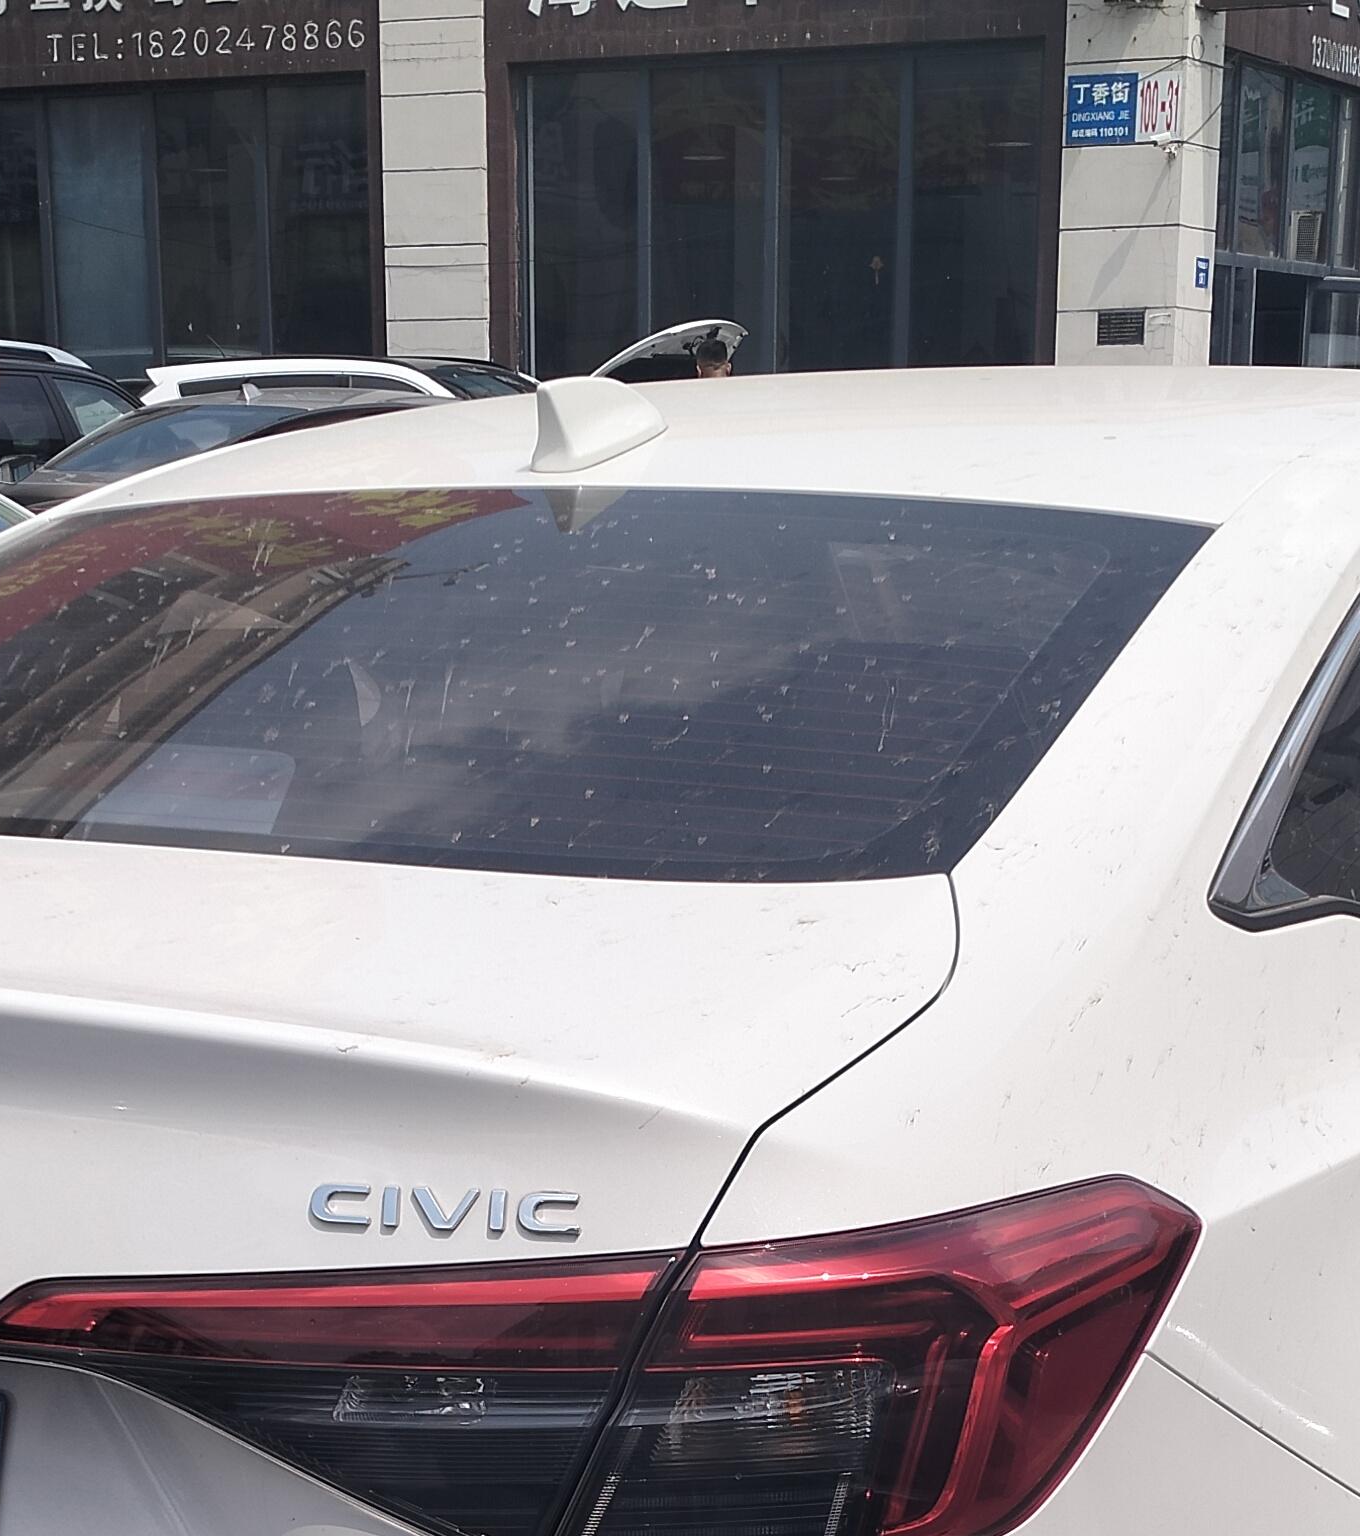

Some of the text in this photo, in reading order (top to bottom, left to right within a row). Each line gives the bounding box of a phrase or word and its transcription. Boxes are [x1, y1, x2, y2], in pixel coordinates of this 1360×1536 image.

[1072, 82, 1131, 106] 丁香街
[1140, 79, 1180, 134] 100-31
[1072, 110, 1131, 123] DINGXIANG JIE
[310, 1182, 582, 1237] CIVIC
